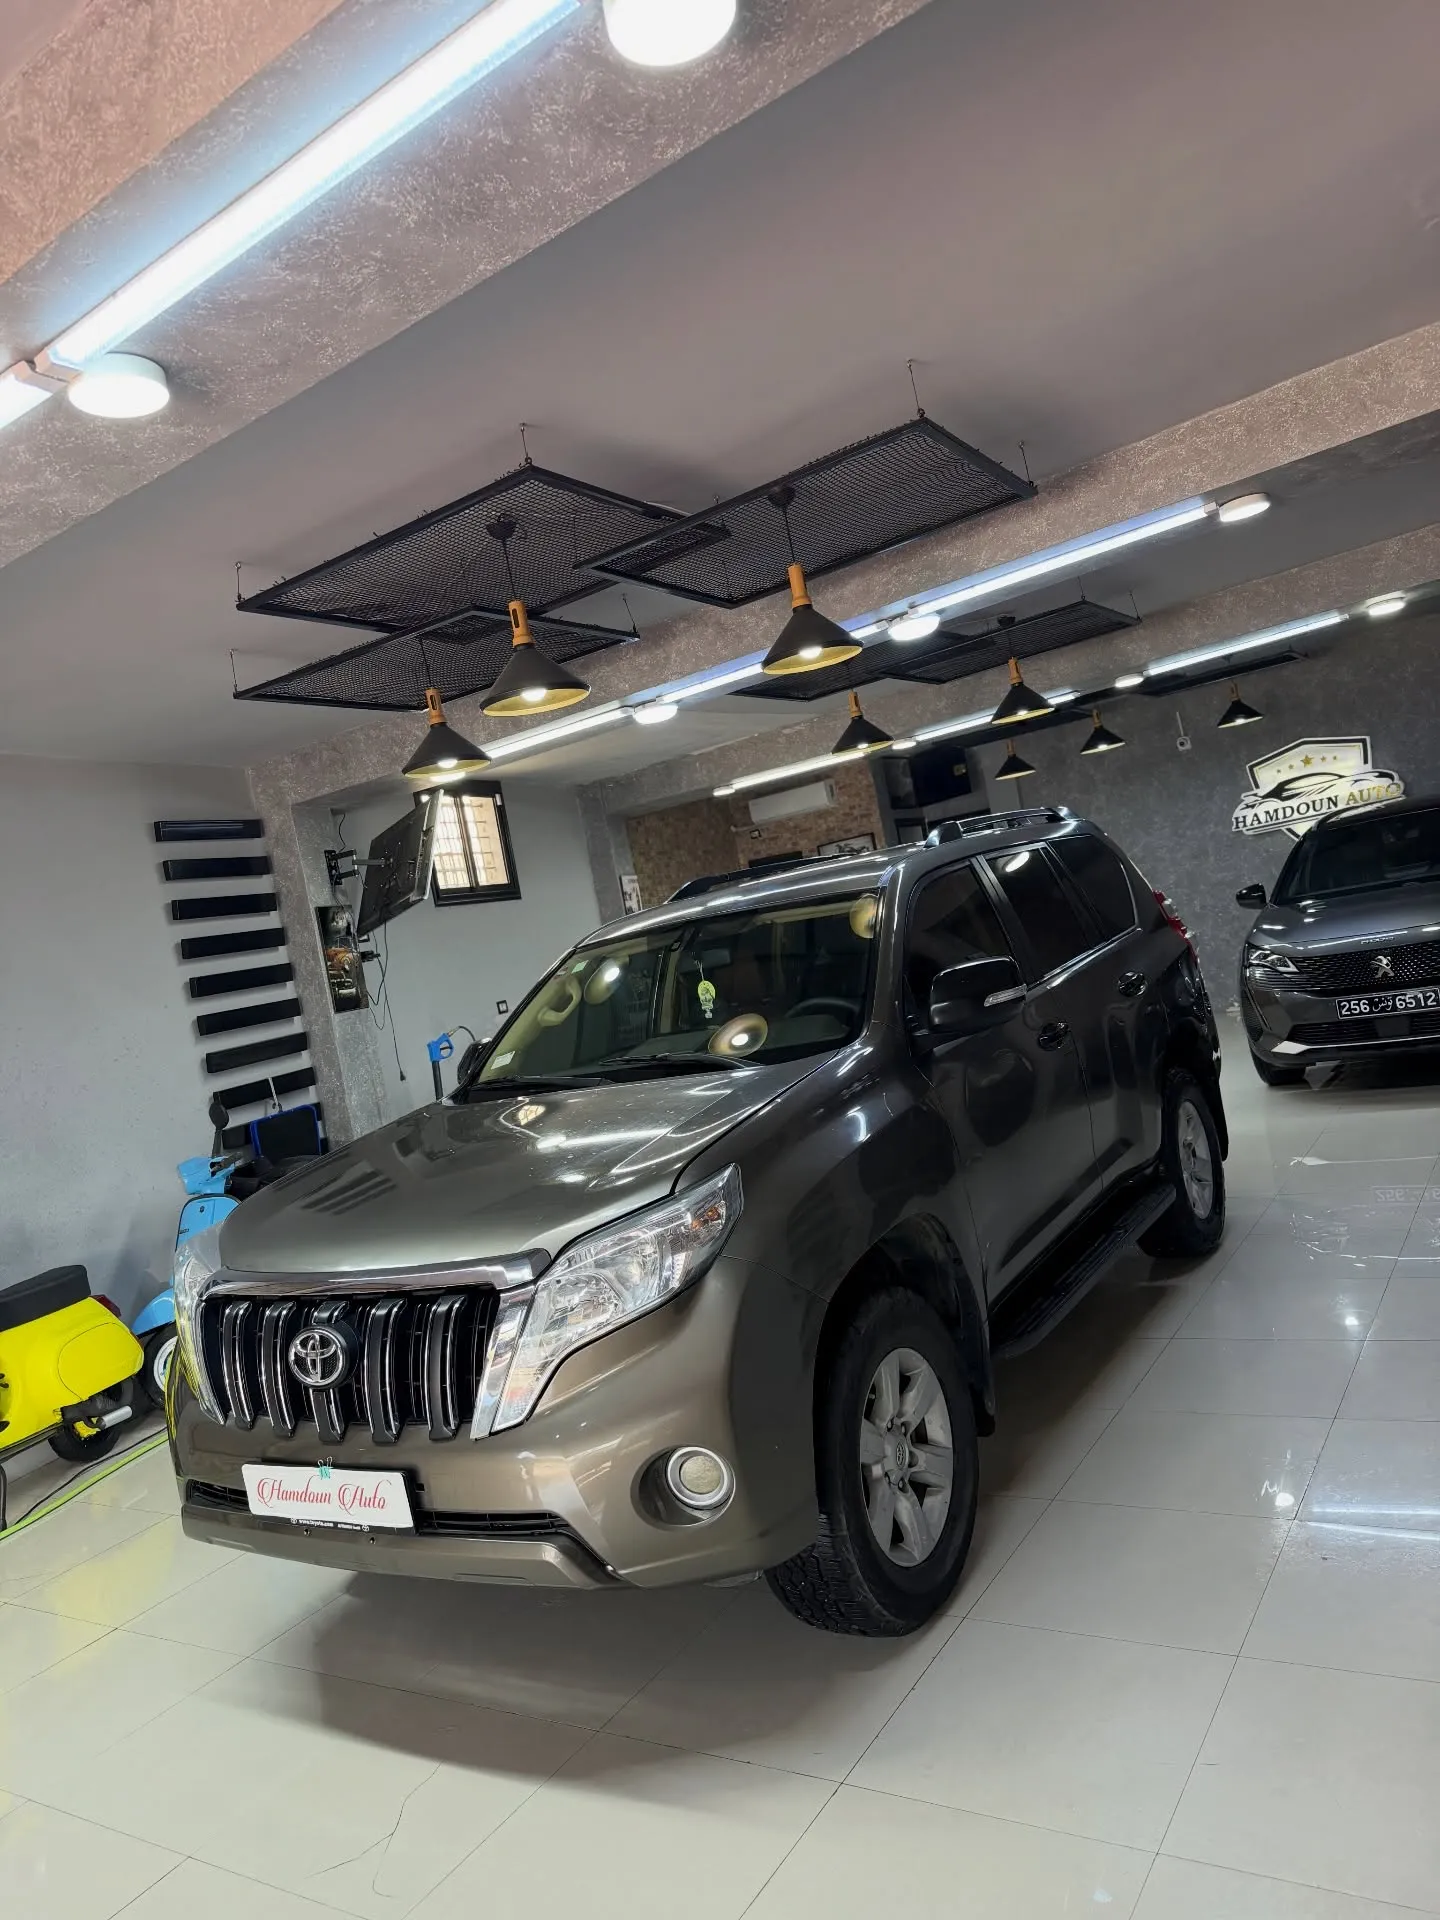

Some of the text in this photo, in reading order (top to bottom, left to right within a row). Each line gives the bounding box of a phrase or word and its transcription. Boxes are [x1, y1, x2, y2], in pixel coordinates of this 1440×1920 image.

[1233, 782, 1401, 829] HAMDOUN AUTO
[1340, 992, 1437, 1015] 256 تونس 6512
[257, 1475, 392, 1516] Hamdoun Auto
